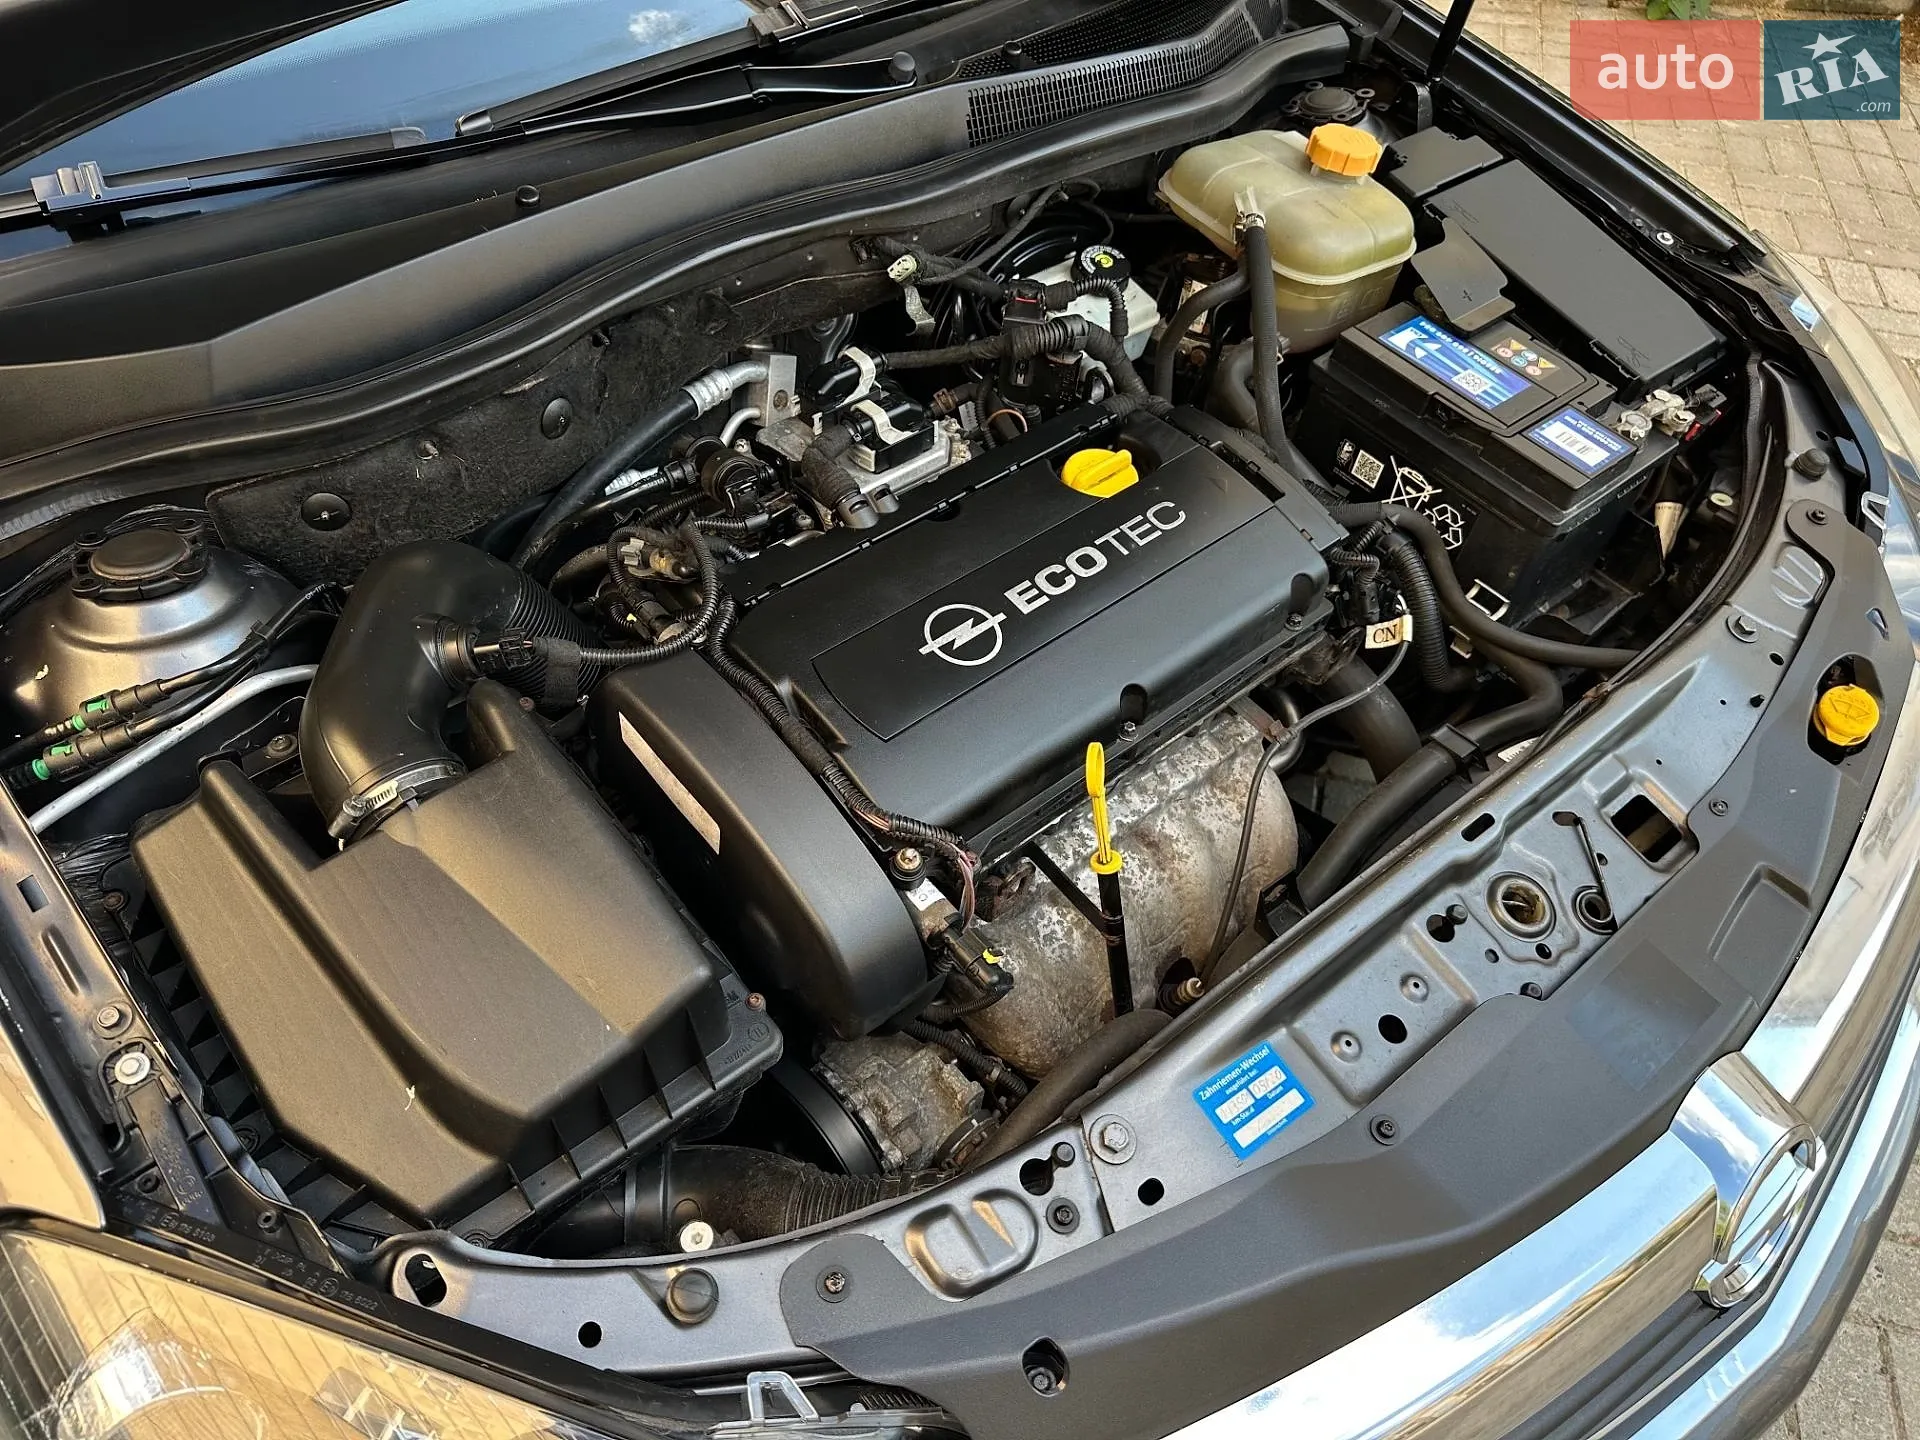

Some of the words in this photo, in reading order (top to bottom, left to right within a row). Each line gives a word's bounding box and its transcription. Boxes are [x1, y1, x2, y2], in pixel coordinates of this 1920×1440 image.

[1003, 501, 1186, 615] ECOTEC
[1373, 624, 1398, 644] CN
[1199, 1045, 1270, 1100] Zahnriemen-Wechsel
